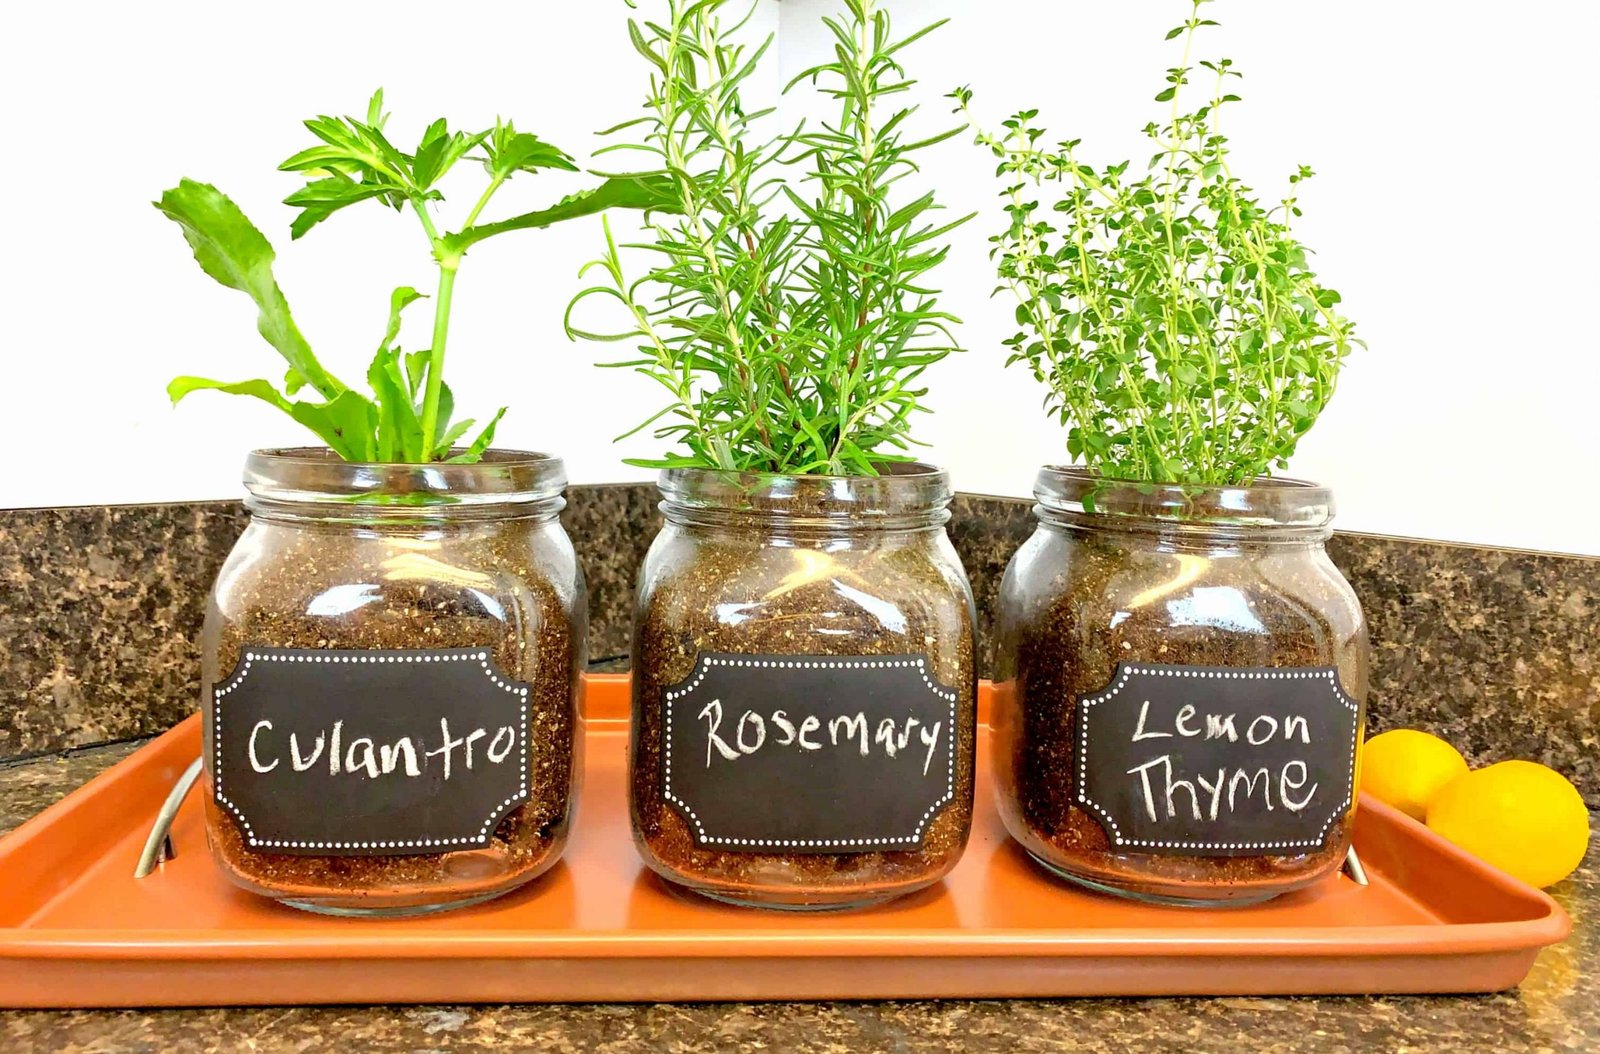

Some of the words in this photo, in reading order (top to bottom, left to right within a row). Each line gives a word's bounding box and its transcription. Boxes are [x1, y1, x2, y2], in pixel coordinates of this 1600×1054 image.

[248, 717, 516, 781] Culantro
[697, 698, 942, 777] Rosemary
[1131, 700, 1311, 745] Lemon
[1126, 754, 1318, 823] Thyme
